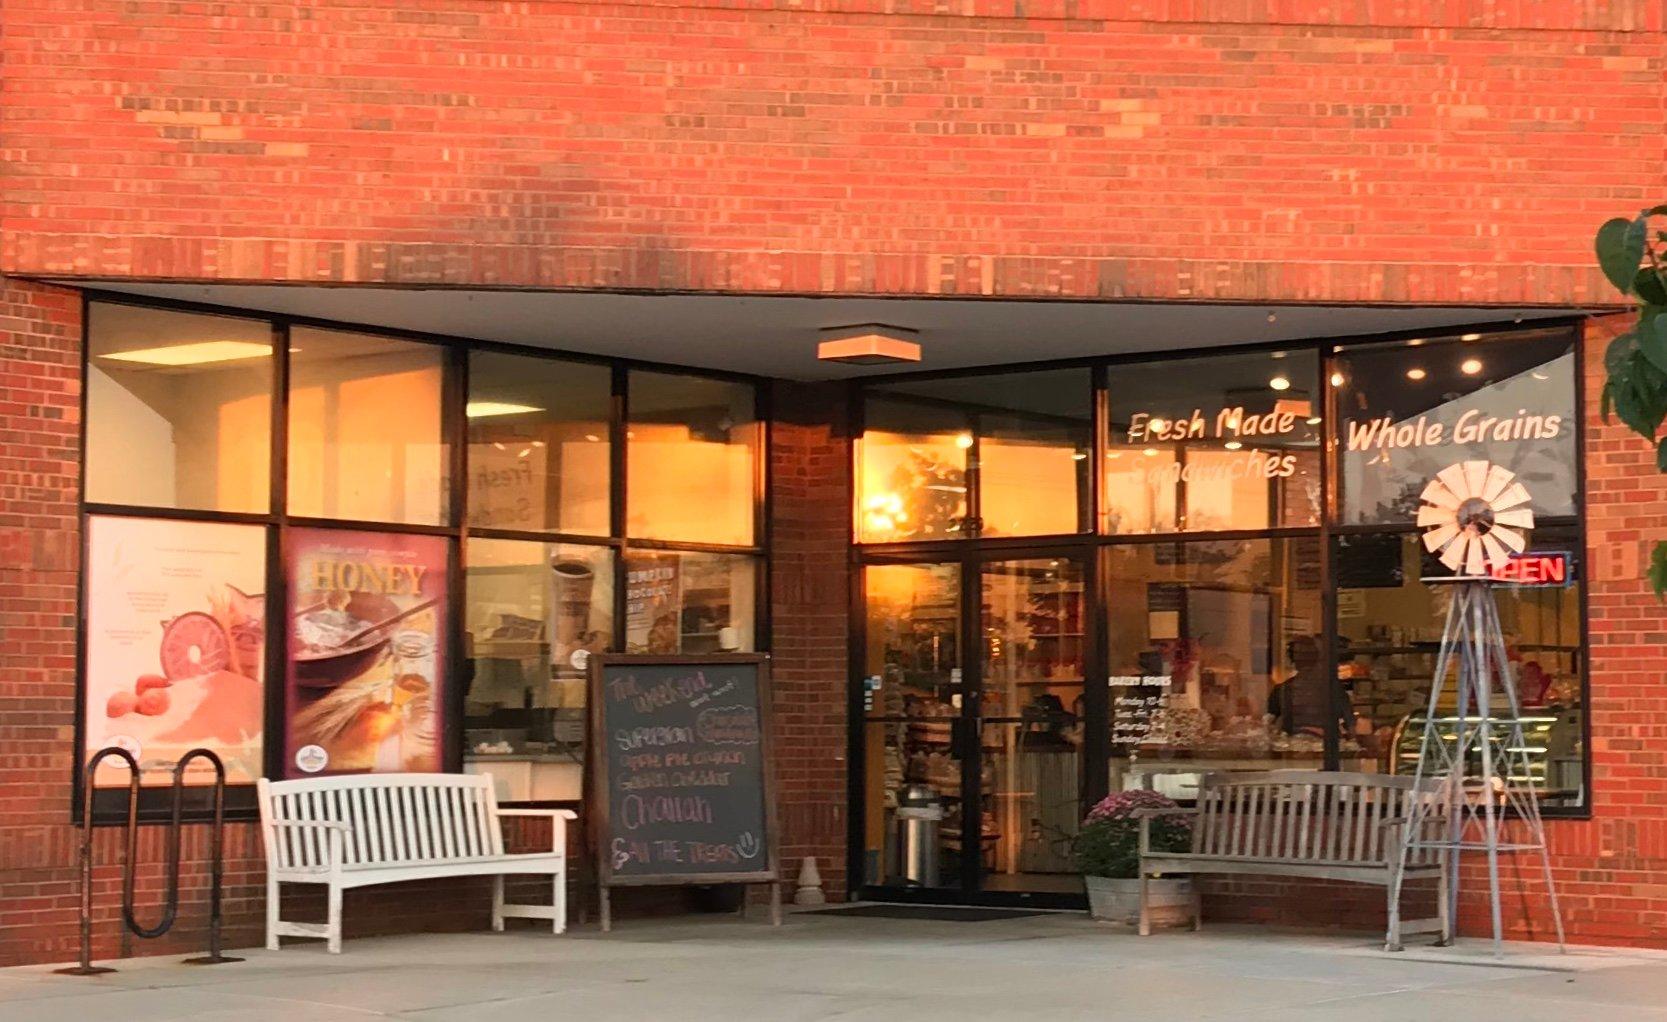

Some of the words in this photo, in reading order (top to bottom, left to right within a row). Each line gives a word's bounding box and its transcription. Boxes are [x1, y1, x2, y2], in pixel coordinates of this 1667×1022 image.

[1126, 408, 1206, 444] Fresh
[1215, 403, 1296, 438] Made
[1348, 417, 1443, 451] Whole
[1453, 409, 1561, 443] Grains
[312, 560, 427, 595] HONEY
